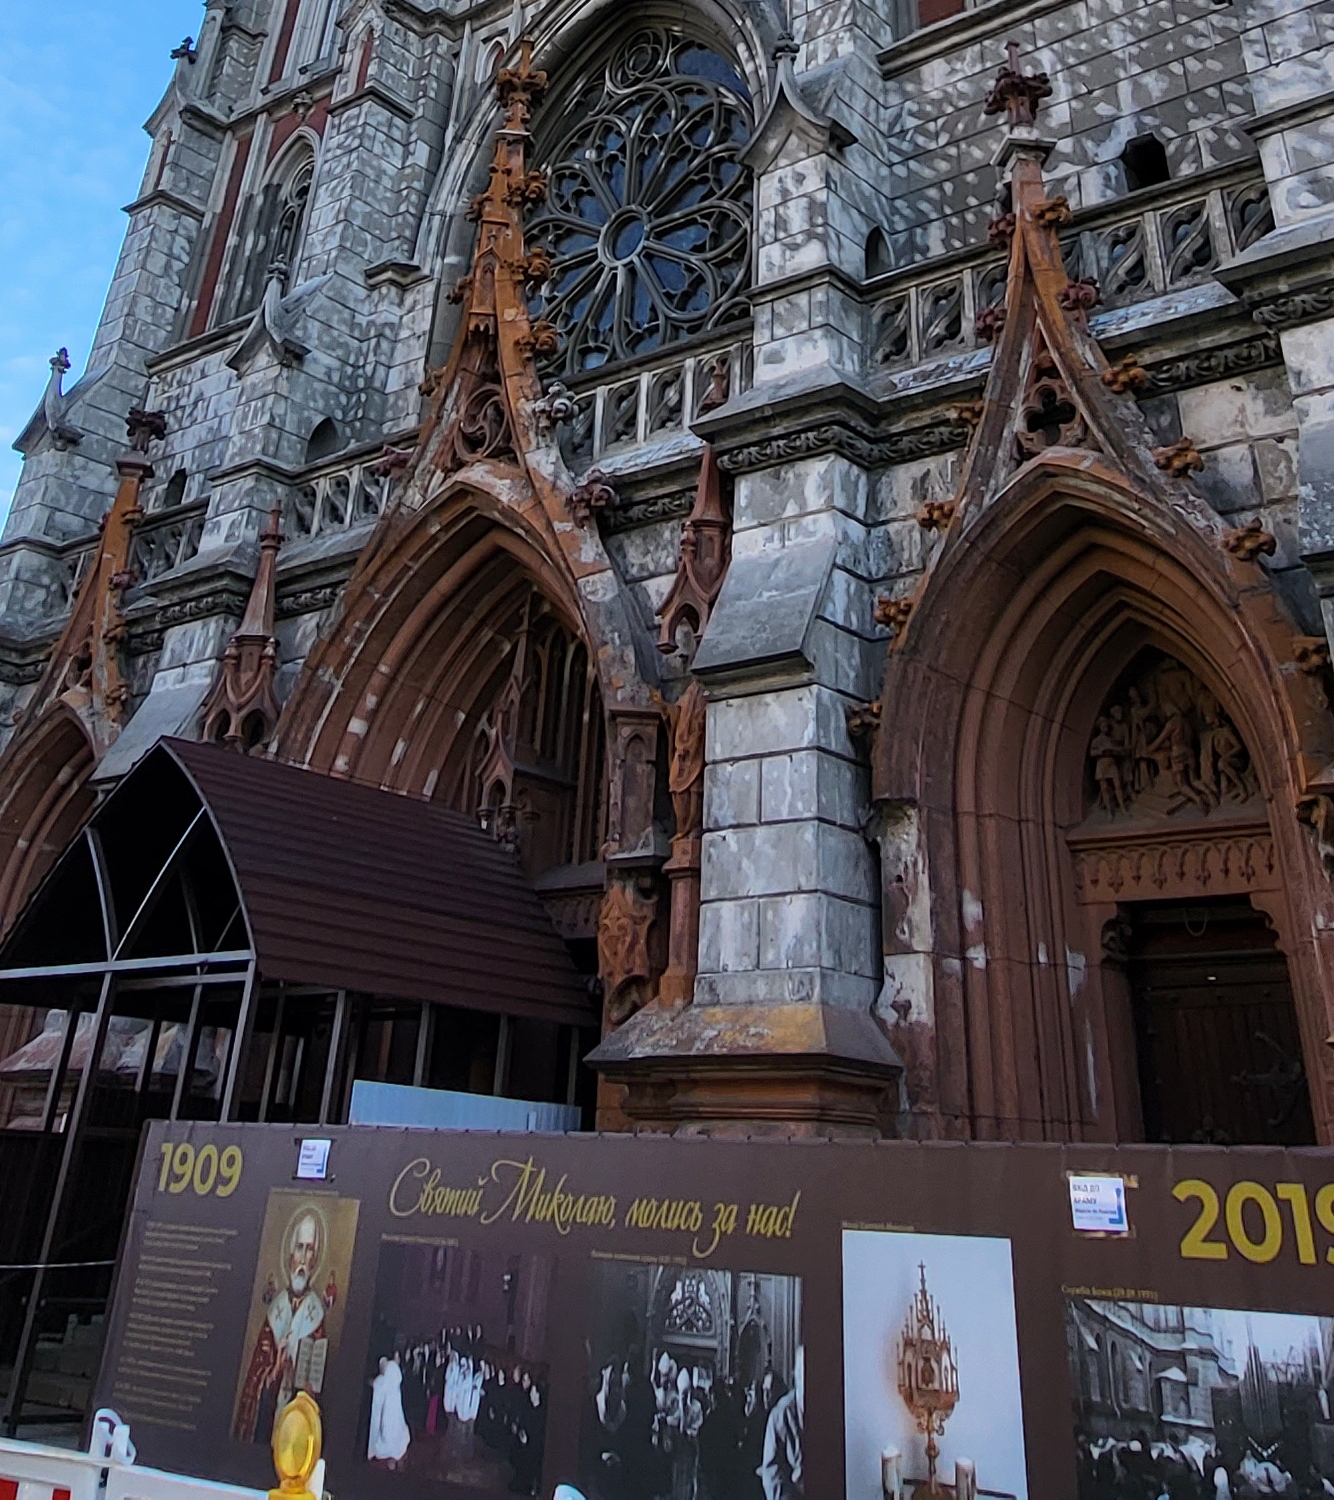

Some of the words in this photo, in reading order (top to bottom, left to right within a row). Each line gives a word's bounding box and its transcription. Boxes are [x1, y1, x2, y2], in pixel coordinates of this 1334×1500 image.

[157, 1142, 243, 1197] 1909
[389, 1157, 489, 1218] Святий
[481, 1155, 617, 1235] Миколаю,
[624, 1195, 703, 1233] молись
[692, 1202, 739, 1259] за
[746, 1190, 802, 1239] нас!
